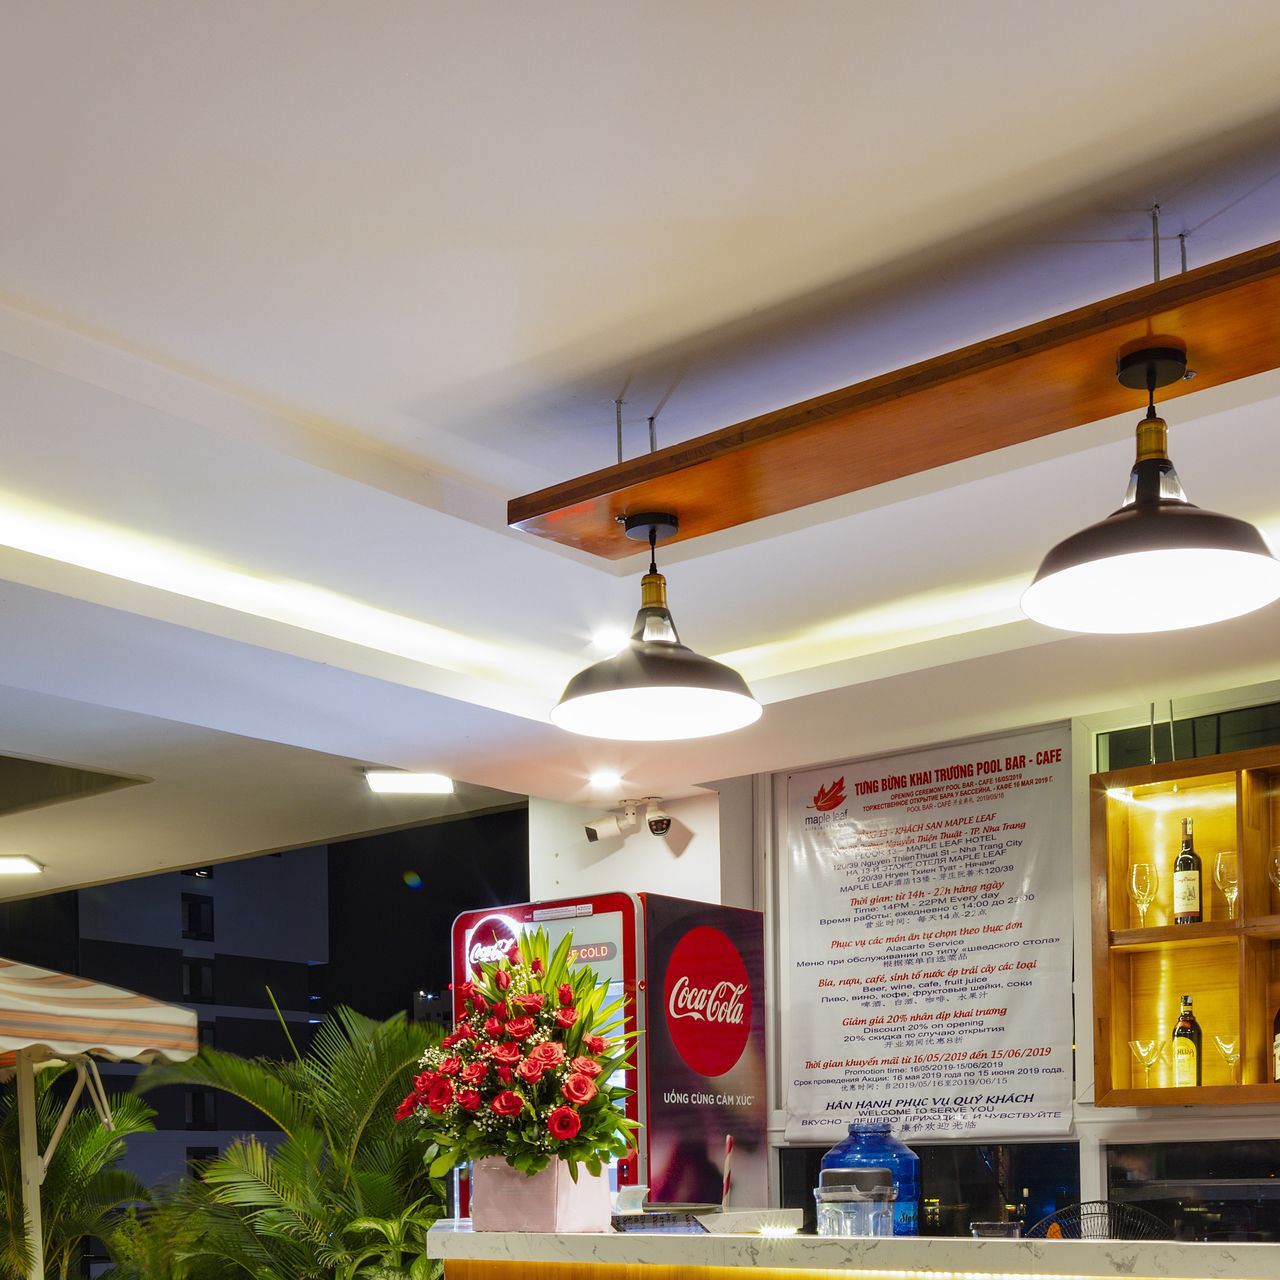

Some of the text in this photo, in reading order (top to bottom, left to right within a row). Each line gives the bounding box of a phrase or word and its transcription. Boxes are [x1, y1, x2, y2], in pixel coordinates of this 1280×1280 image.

[910, 770, 932, 786] KHAI
[976, 759, 1002, 775] POOL
[1005, 755, 1026, 770] BAR
[1036, 748, 1062, 766] CAFE
[890, 780, 974, 800] OPENING CEREMONY POOL BAR
[805, 808, 848, 826] maple leaf
[944, 816, 974, 827] MAPLE
[976, 813, 997, 823] LEAF
[983, 822, 1026, 833] Nha Trang
[906, 834, 997, 852] MAPLE LEAF HOTEL
[861, 858, 890, 868] Nguyen
[979, 843, 1004, 851] Trang
[1006, 840, 1023, 848] City
[949, 853, 980, 862] MAPLE
[983, 849, 1007, 858] LEAF
[857, 874, 882, 882] 120/39
[885, 872, 909, 880] Нгуен
[938, 865, 957, 873] Туат
[840, 884, 870, 893] MAPLE
[870, 895, 893, 906] gian:
[908, 890, 925, 899] 14h
[934, 887, 951, 896] 22h
[954, 884, 977, 894] hàng
[980, 881, 1005, 891] ngày
[883, 902, 909, 910] 14PM
[919, 898, 947, 907] 22PM
[950, 895, 978, 903] Every
[981, 892, 1000, 901] day
[820, 901, 988, 926] Время работы: ежедневно 14:00
[831, 921, 1022, 949] Phục vụ các món chọn theo thực đơn
[580, 946, 608, 958] COLD
[886, 939, 965, 952] Alacarte Service
[796, 960, 824, 968] Меню
[847, 952, 918, 963] обслуживании
[818, 960, 1037, 987] Bia, rượu, café, sinh tố nước ép trái cây các loại
[918, 980, 941, 988] cafe,
[944, 978, 963, 986] fruit
[965, 976, 988, 985] juice
[912, 987, 968, 998] фруктовые
[1006, 980, 1033, 988] соки
[669, 976, 748, 1024] Coca-Cola
[842, 1007, 1008, 1026] Giảm giá 20% nhân dịp khai trương
[863, 1026, 905, 1034] Discount
[908, 1023, 928, 1031] 20%
[947, 1020, 984, 1029] opening
[918, 1030, 955, 1038] случаю
[958, 1026, 1005, 1035] открытия
[805, 1047, 1052, 1070] Thời gian khuyến mãi 16/05/2019 đến 15/06/2019
[910, 1062, 1004, 1073] 16/05/2019-15/06/2019
[1018, 1067, 1040, 1075] 2019
[664, 1089, 689, 1104] UỐNG
[691, 1091, 714, 1105] CÙNG
[717, 1092, 734, 1105] CẢM
[826, 1093, 1034, 1111] HÂN HẠNH PHỤC VỤ QUÝ KHÁCH
[858, 1108, 911, 1117] WELCOME
[930, 1106, 967, 1114] SERVE
[984, 1111, 1062, 1119] ЧУВСТВУЙТЕ
